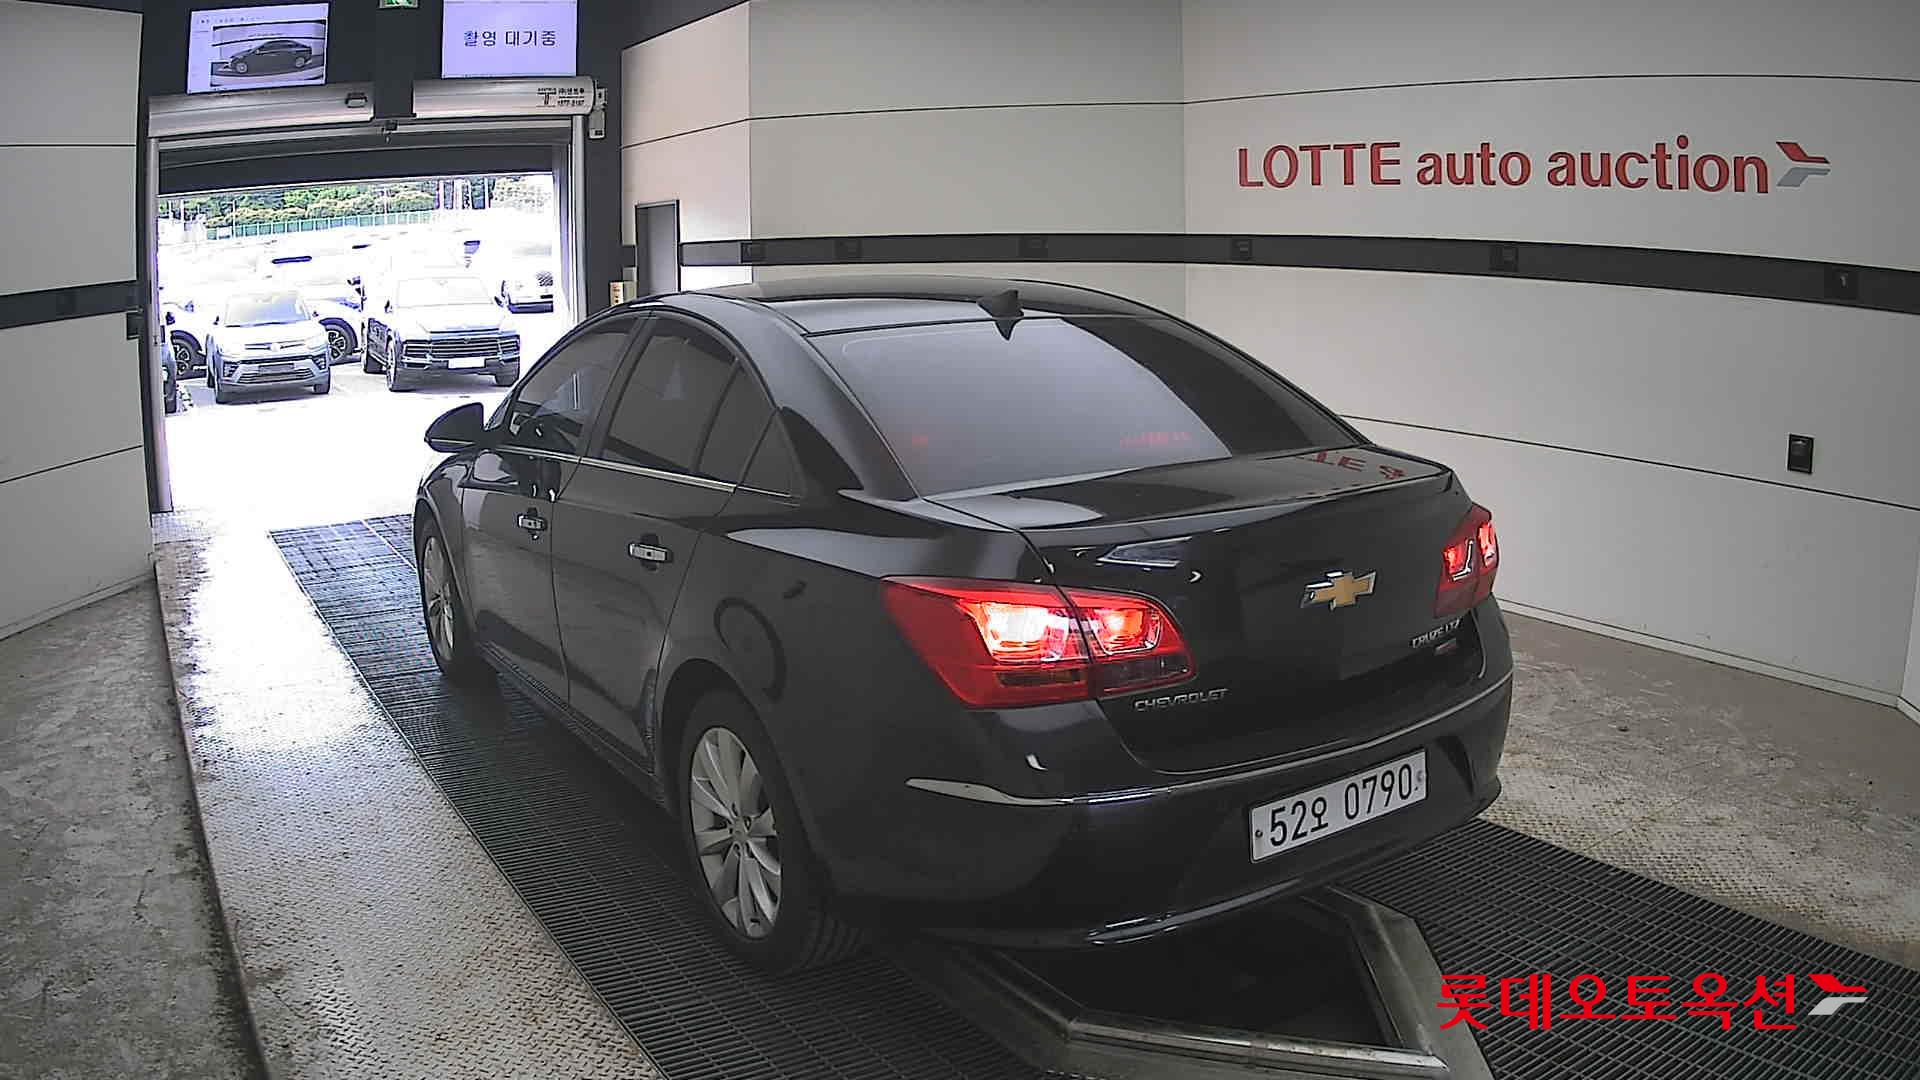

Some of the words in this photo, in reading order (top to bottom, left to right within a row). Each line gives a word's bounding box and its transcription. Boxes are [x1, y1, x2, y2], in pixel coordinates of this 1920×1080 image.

[505, 30, 557, 47] 대기중
[1238, 142, 1401, 188] LOTTE
[1416, 142, 1532, 186] auto
[1547, 134, 1769, 194] auction
[1134, 687, 1229, 712] CHEVROLET
[1269, 796, 1329, 847] 52오
[1344, 763, 1412, 820] 0790
